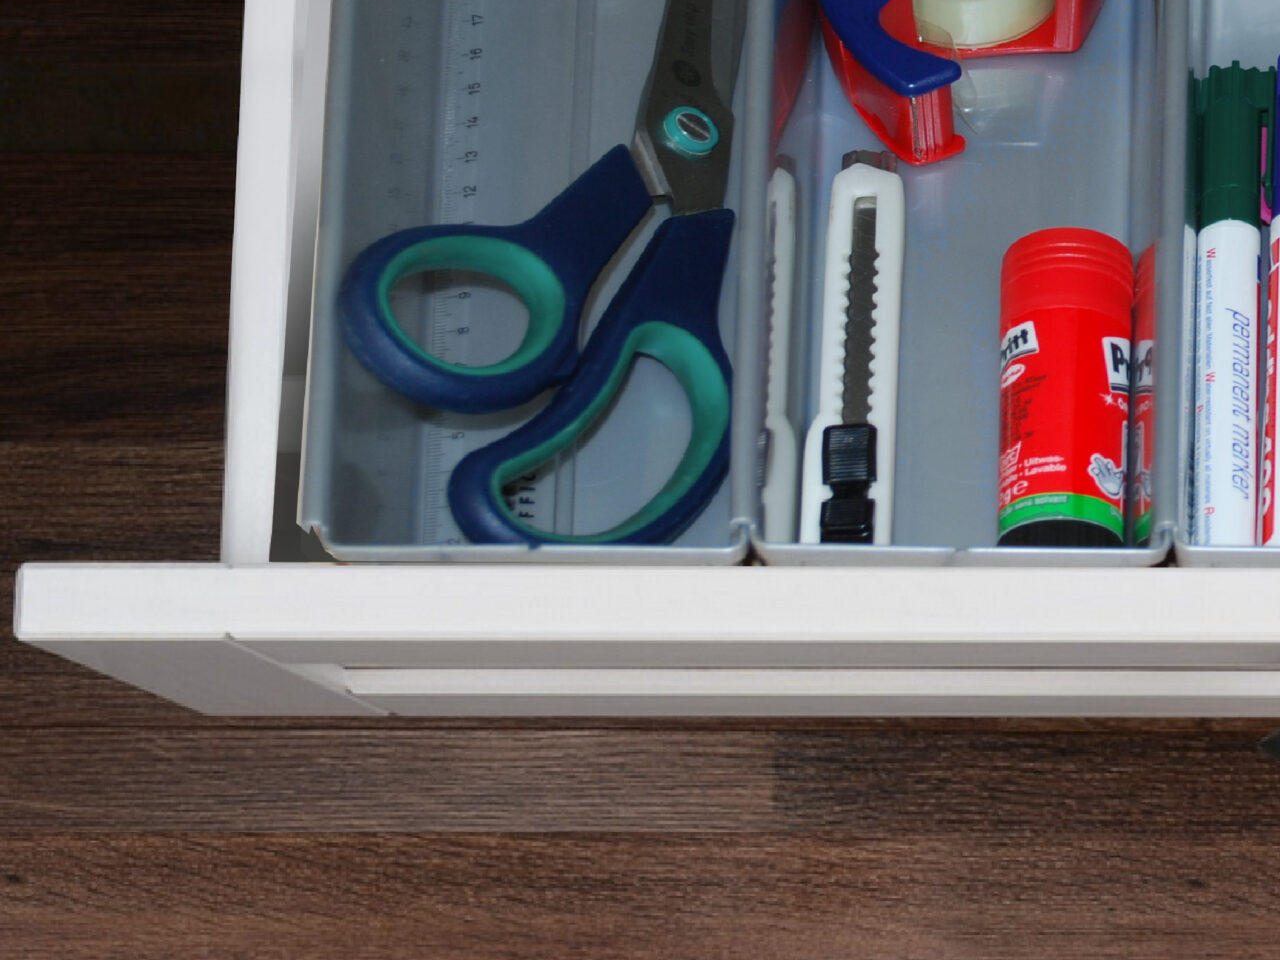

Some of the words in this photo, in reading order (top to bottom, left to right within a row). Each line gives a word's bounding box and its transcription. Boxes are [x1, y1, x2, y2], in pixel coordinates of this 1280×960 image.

[471, 14, 485, 26] 17
[469, 48, 483, 61] 16
[468, 82, 481, 96] 15
[466, 116, 480, 129] 14
[465, 150, 479, 163] 13
[463, 185, 477, 198] 12
[1226, 308, 1252, 422] permanent
[1232, 424, 1253, 500] marker
